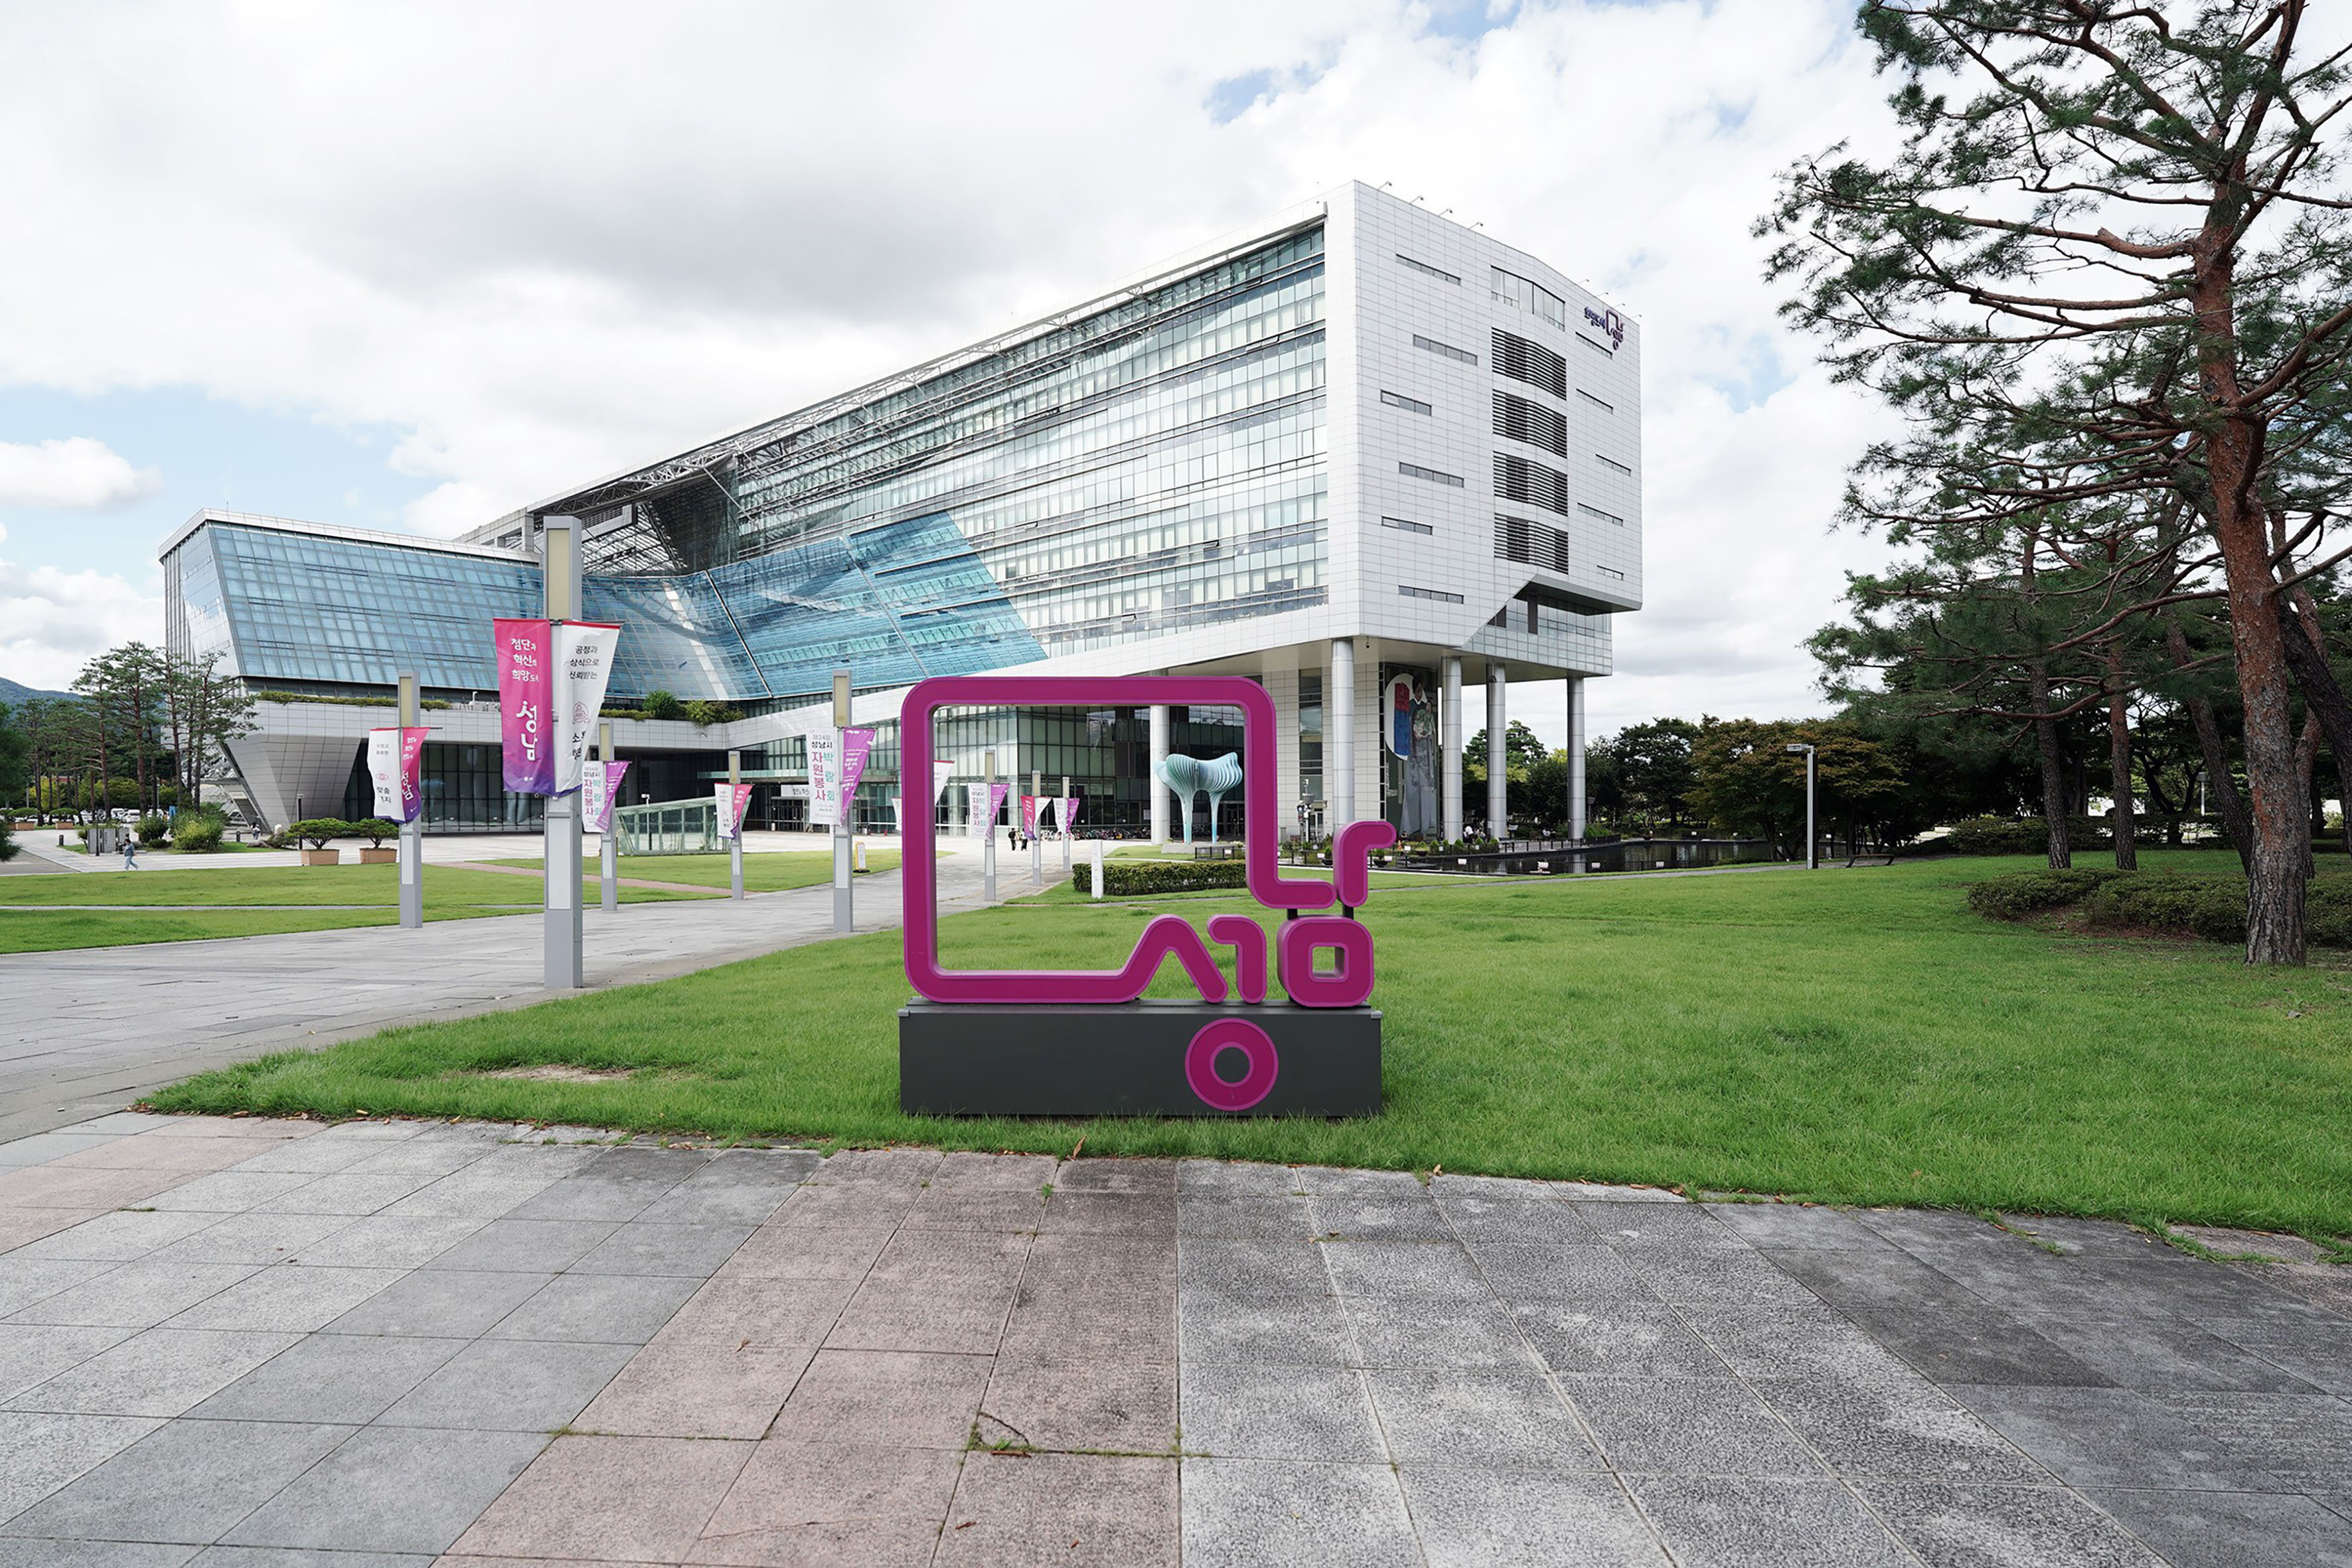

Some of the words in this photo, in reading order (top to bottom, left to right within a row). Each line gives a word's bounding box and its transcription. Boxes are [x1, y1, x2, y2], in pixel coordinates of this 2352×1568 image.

[510, 638, 536, 651] 첨단과
[576, 645, 598, 655] 공정과
[570, 658, 599, 667] 상식으로
[569, 671, 598, 680] 신뢰받는
[516, 700, 538, 761] 성남
[812, 751, 826, 801] 자원봉사
[823, 751, 835, 801] 박람회
[584, 779, 594, 815] 자원봉사
